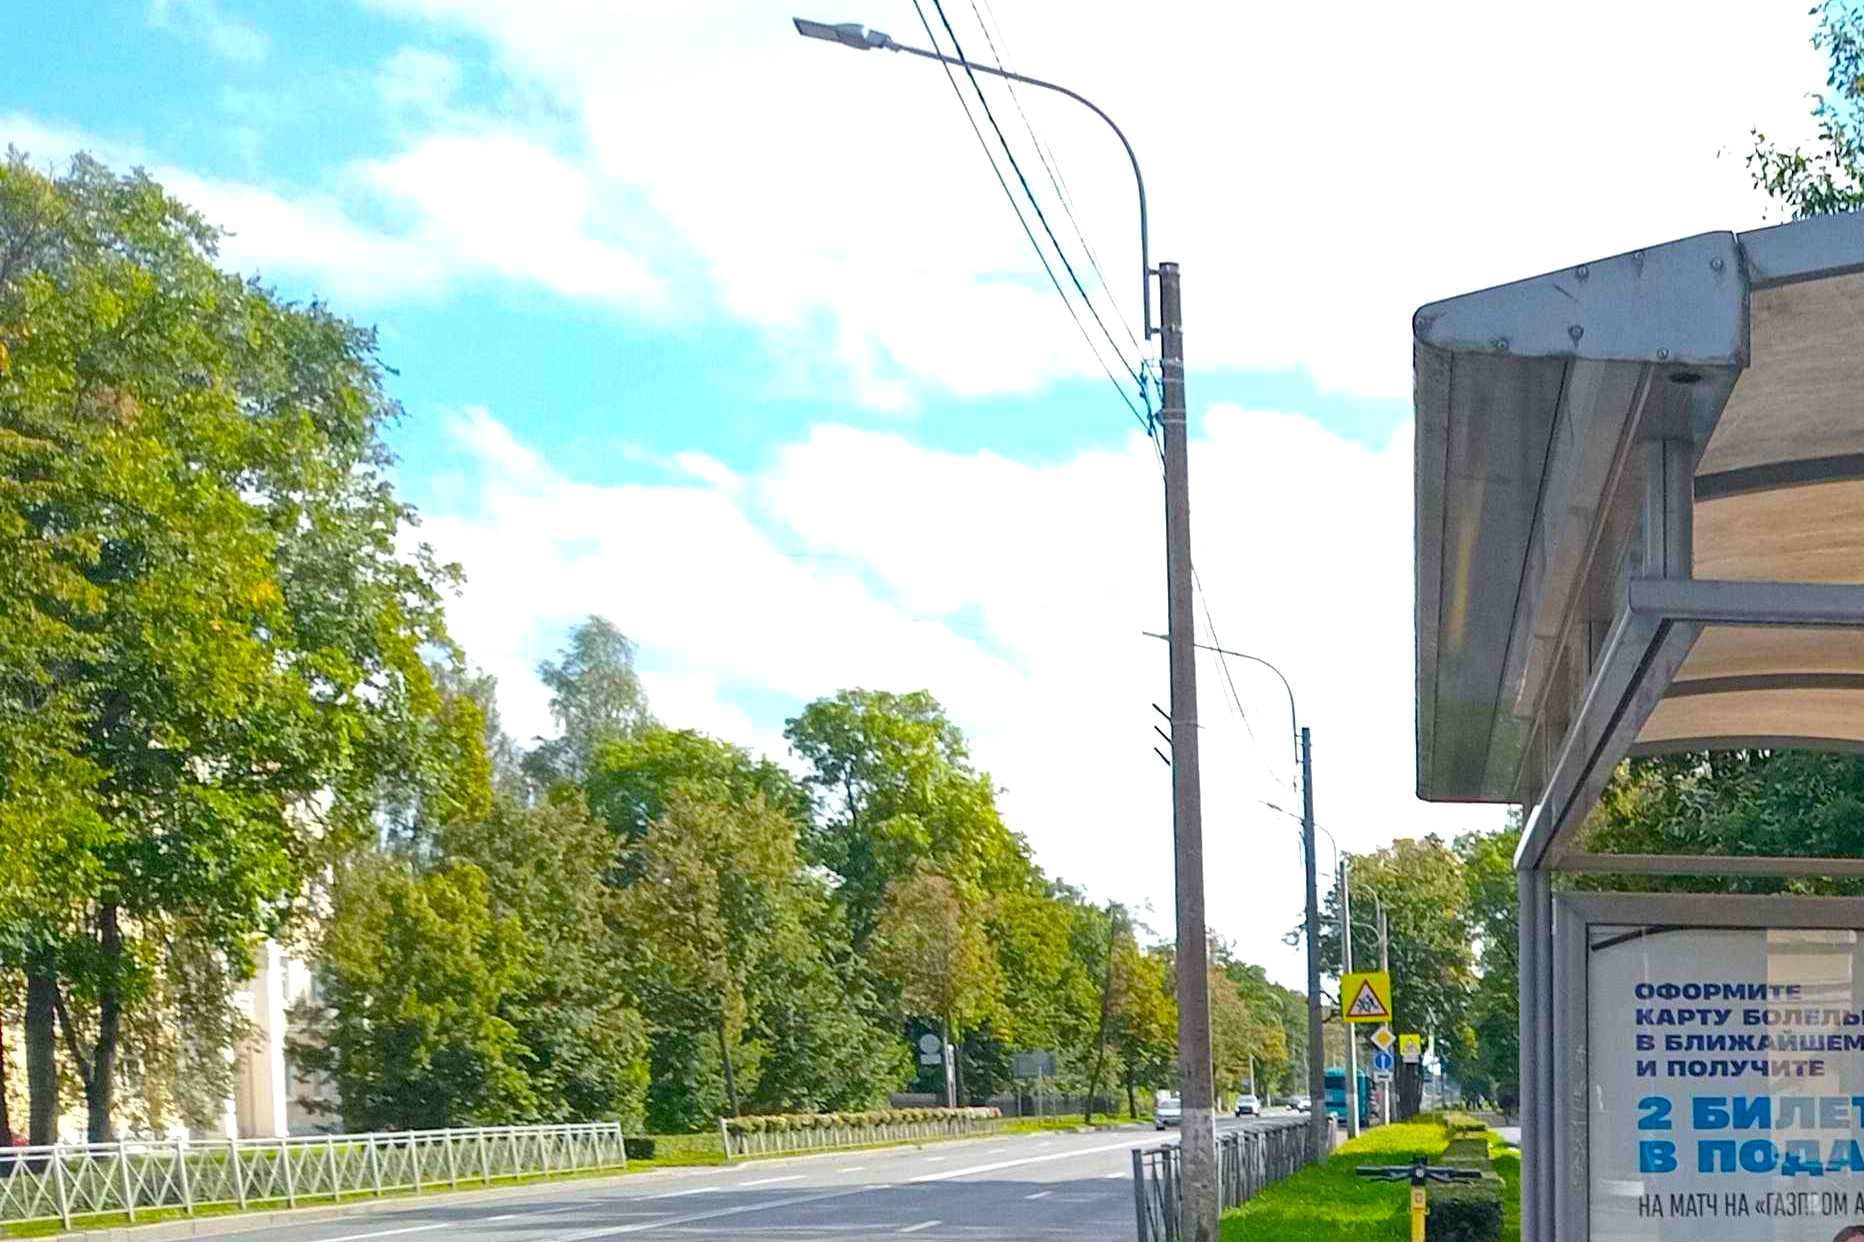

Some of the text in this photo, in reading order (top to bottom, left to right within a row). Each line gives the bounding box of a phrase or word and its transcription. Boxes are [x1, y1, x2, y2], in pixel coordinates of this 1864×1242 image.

[1634, 983, 1801, 1000] ОФОРМИТЕ
[1635, 1008, 1732, 1026] КАРТУ
[1636, 1034, 1656, 1051] В
[1636, 1060, 1825, 1077] И ПОЛУЧИТЕ
[1637, 1096, 1673, 1130] 2
[1639, 1139, 1678, 1173] В
[1639, 1194, 1663, 1217] НА
[1669, 1193, 1717, 1217] МАТЧ
[1725, 1193, 1750, 1217] НА
